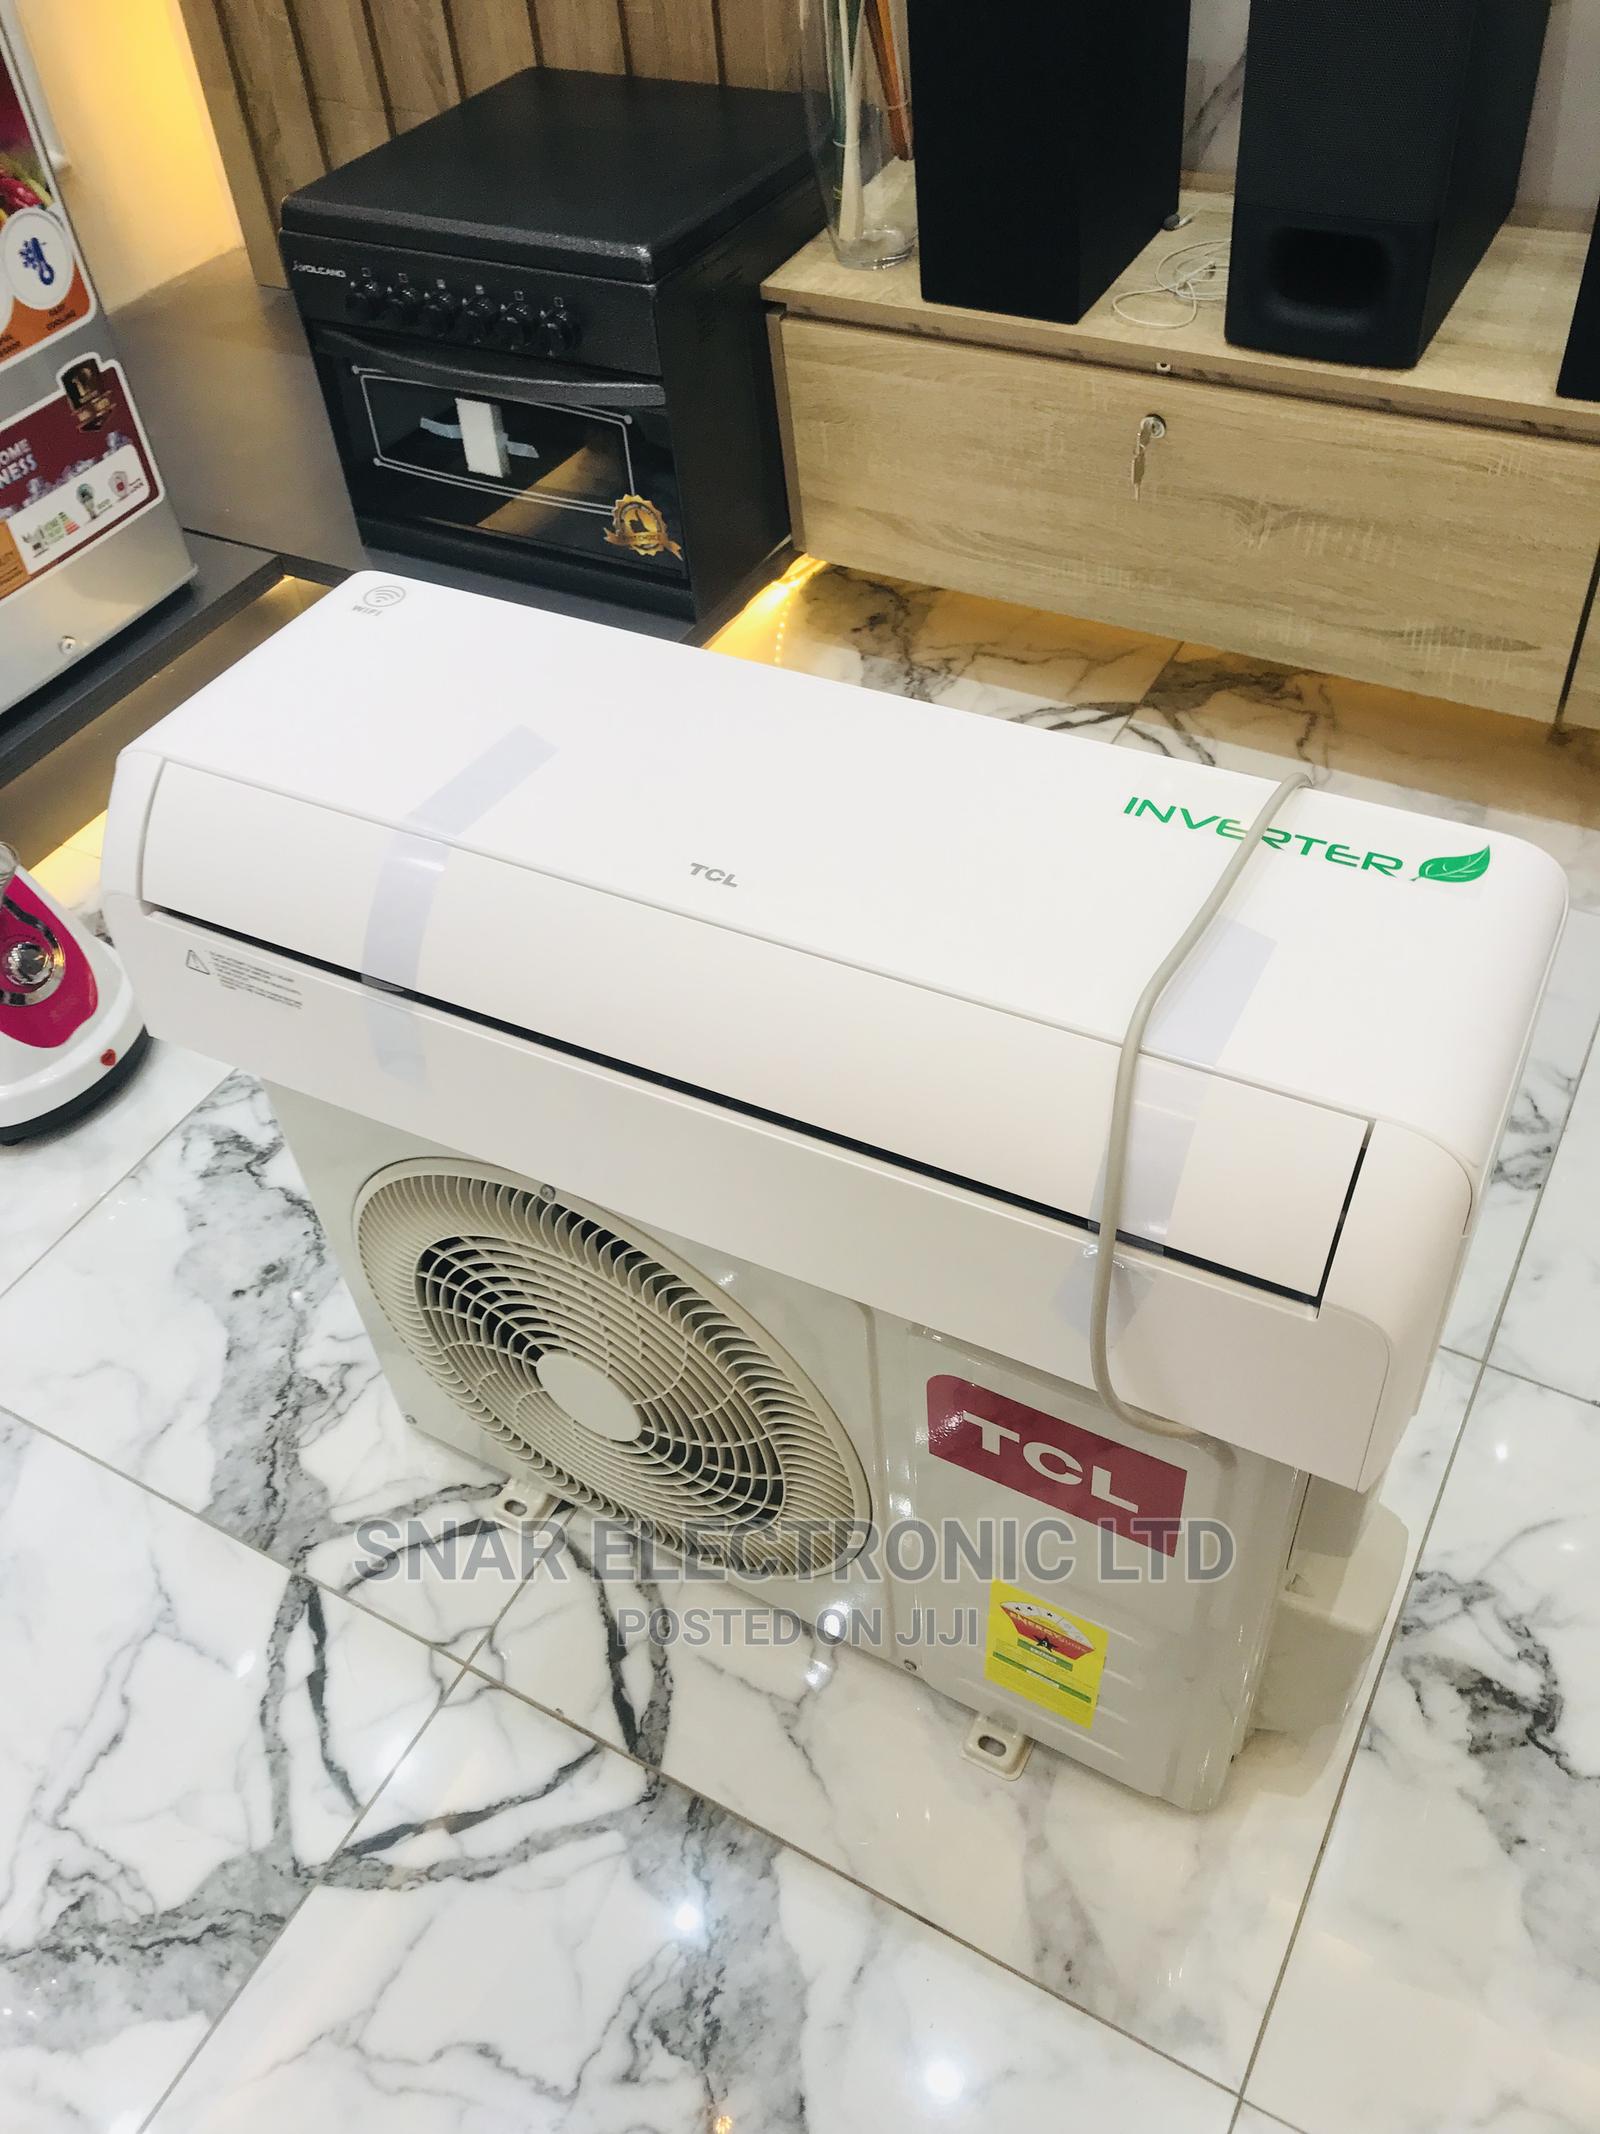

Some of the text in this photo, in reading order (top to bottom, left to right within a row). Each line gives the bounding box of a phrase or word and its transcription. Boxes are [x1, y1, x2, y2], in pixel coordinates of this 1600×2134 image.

[301, 264, 346, 278] VOLCANO
[1123, 797, 1404, 878] INVERTER
[690, 862, 739, 888] TCL
[962, 1410, 1140, 1514] TCL
